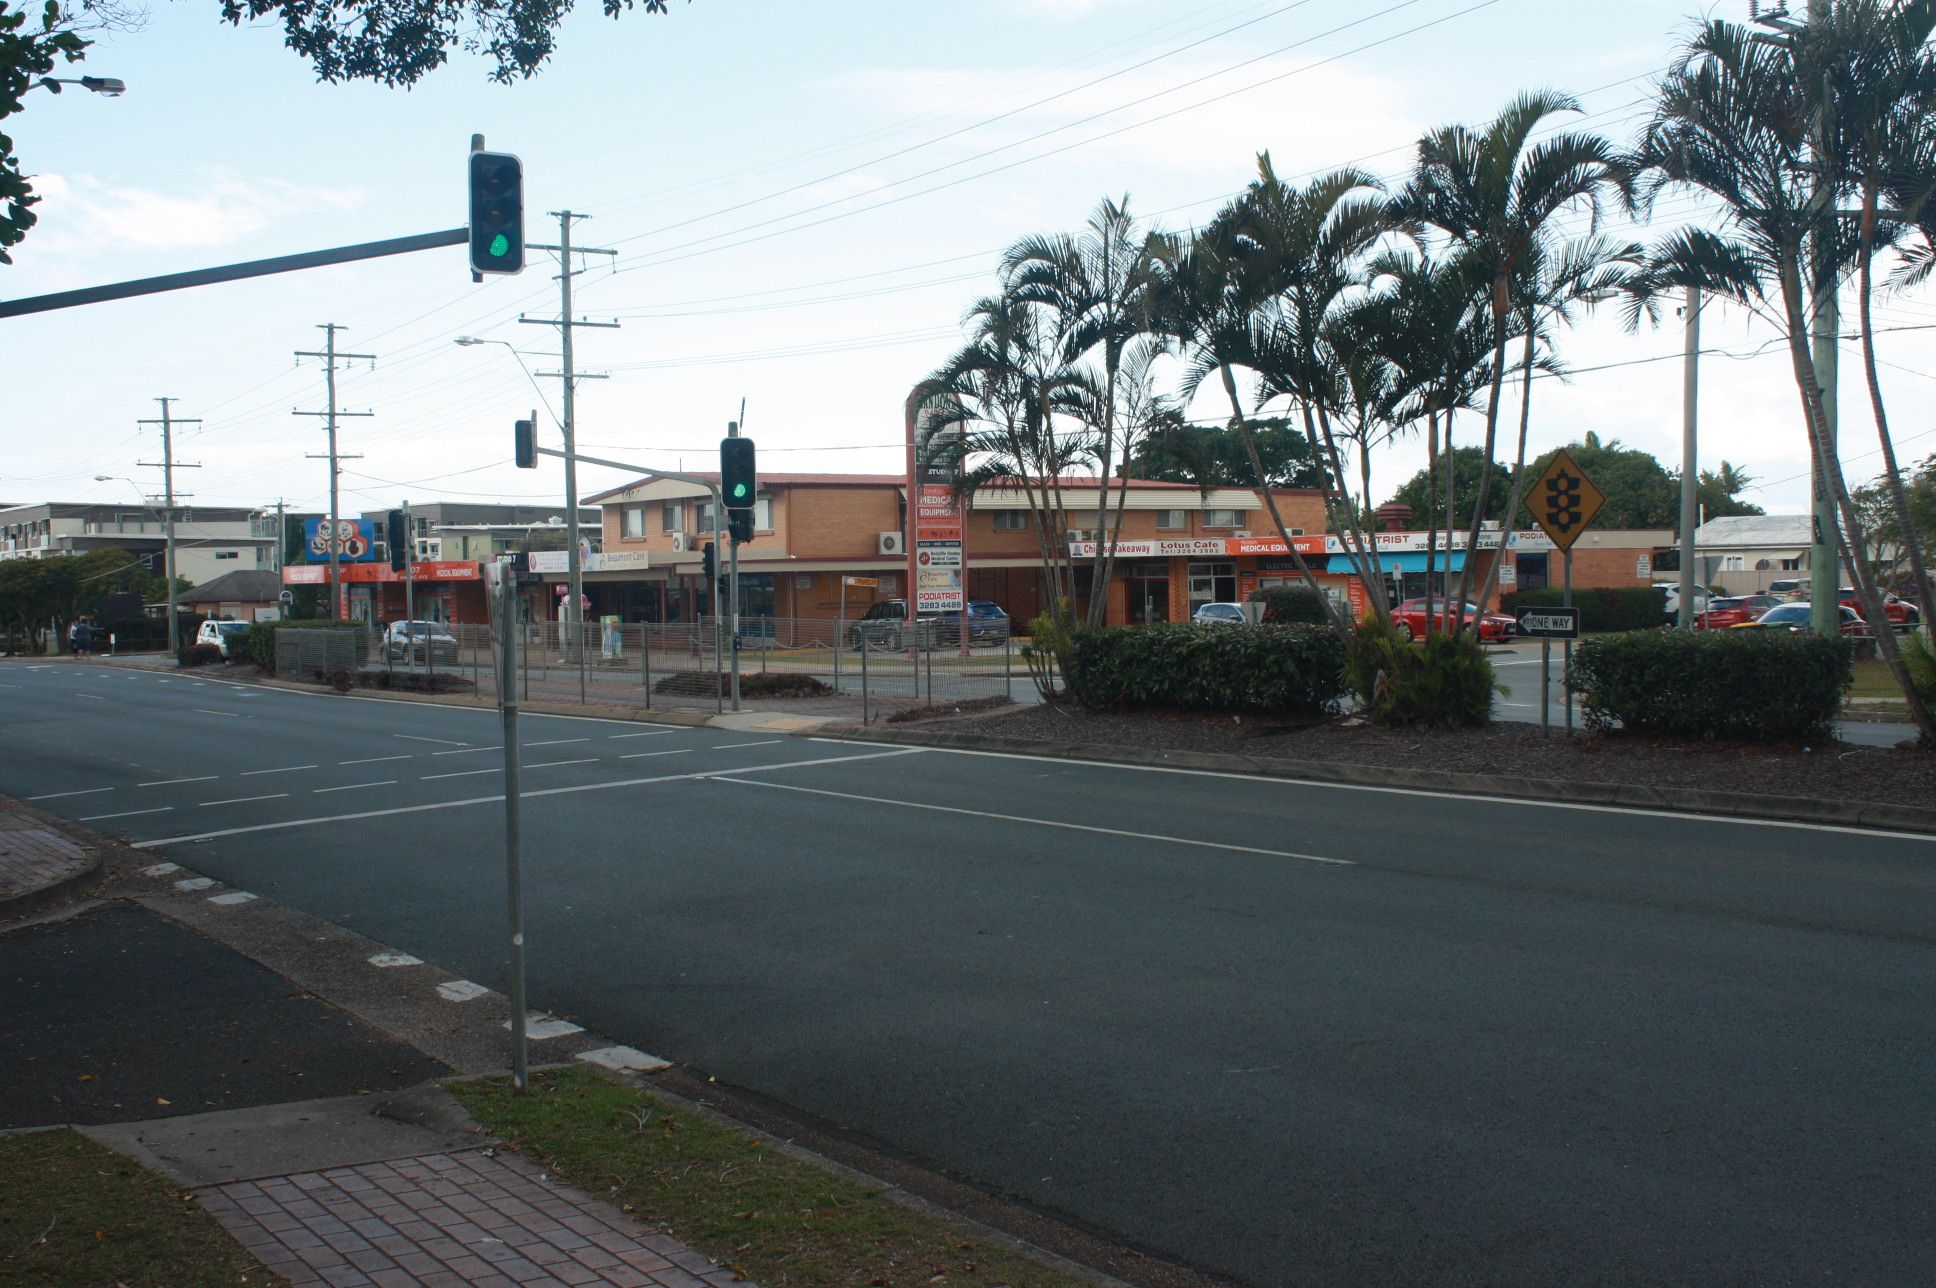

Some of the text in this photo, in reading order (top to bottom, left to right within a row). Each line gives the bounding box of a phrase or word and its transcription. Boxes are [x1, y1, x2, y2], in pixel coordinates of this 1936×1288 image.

[920, 496, 955, 504] MEDICA
[1083, 544, 1112, 553] Chise
[1271, 543, 1310, 552] EQUIENT
[919, 592, 961, 600] PODIATRIST
[941, 601, 961, 609] 4488
[1531, 616, 1570, 629] ONE WAY
